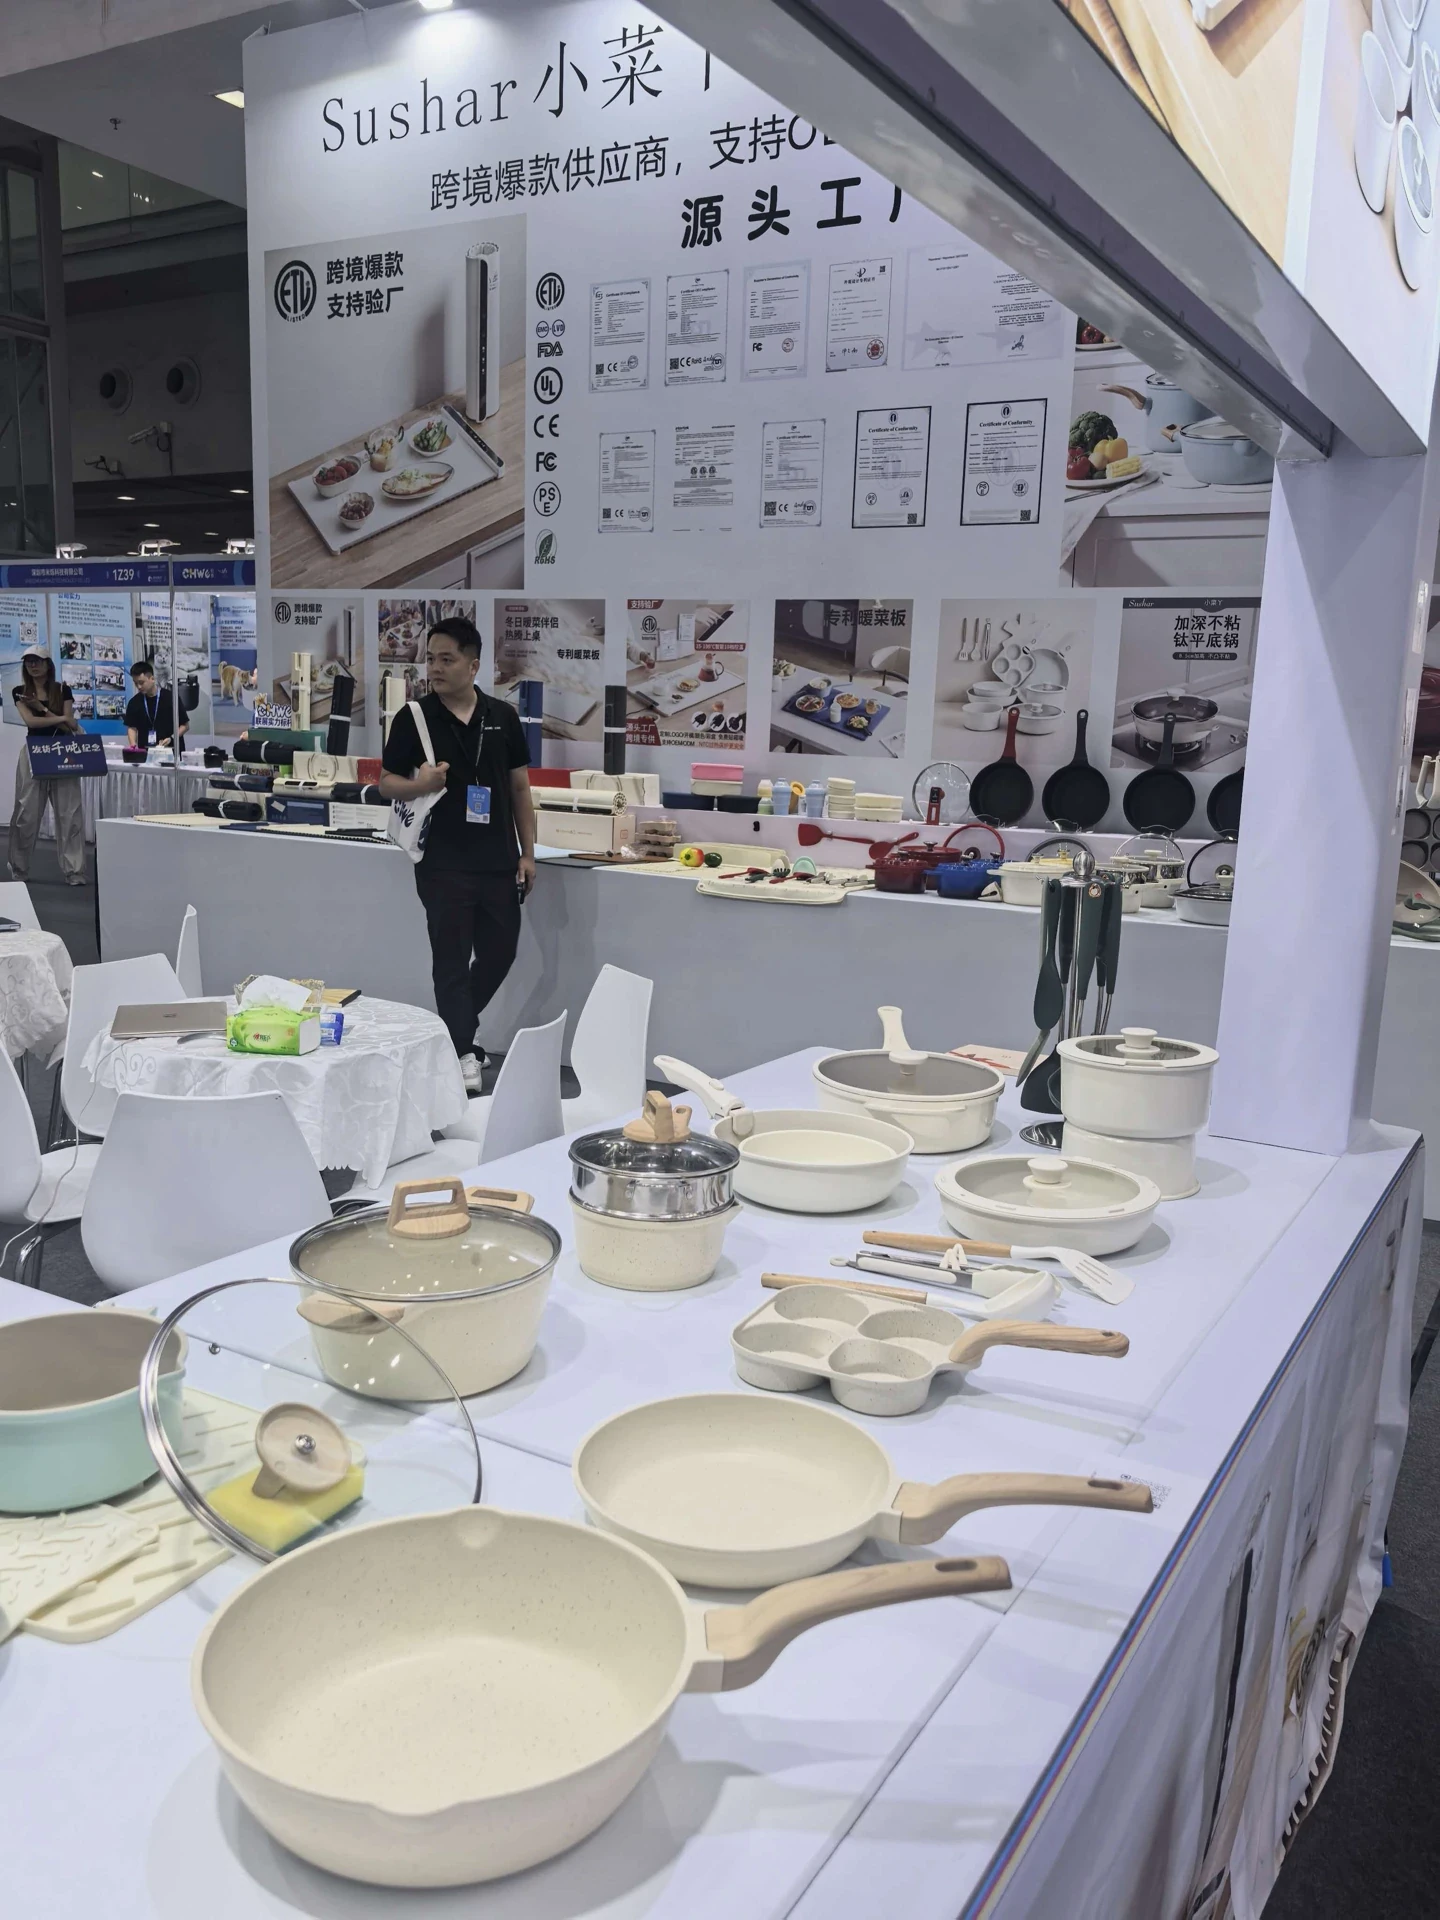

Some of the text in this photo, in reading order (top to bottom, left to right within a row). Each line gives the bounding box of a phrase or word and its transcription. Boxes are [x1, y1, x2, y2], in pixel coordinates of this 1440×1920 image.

[323, 77, 517, 153] Sushar
[326, 250, 404, 285] 跨境爆款
[326, 286, 404, 320] 支持验厂
[537, 340, 564, 359] FDA
[533, 413, 560, 439] CE
[113, 568, 135, 581] 1Z39
[294, 603, 323, 613] 跨境爆款
[1128, 599, 1155, 608] Sushar
[294, 615, 323, 626] 支持验厂
[505, 616, 559, 629] 冬日暖菜伴侣
[827, 608, 907, 627] 专利暖菜板
[1173, 614, 1242, 632] 加深不粘
[505, 630, 541, 642] 热腾上桌
[1173, 632, 1240, 649] 钛平底锅
[557, 648, 600, 661] 专利暖菜板
